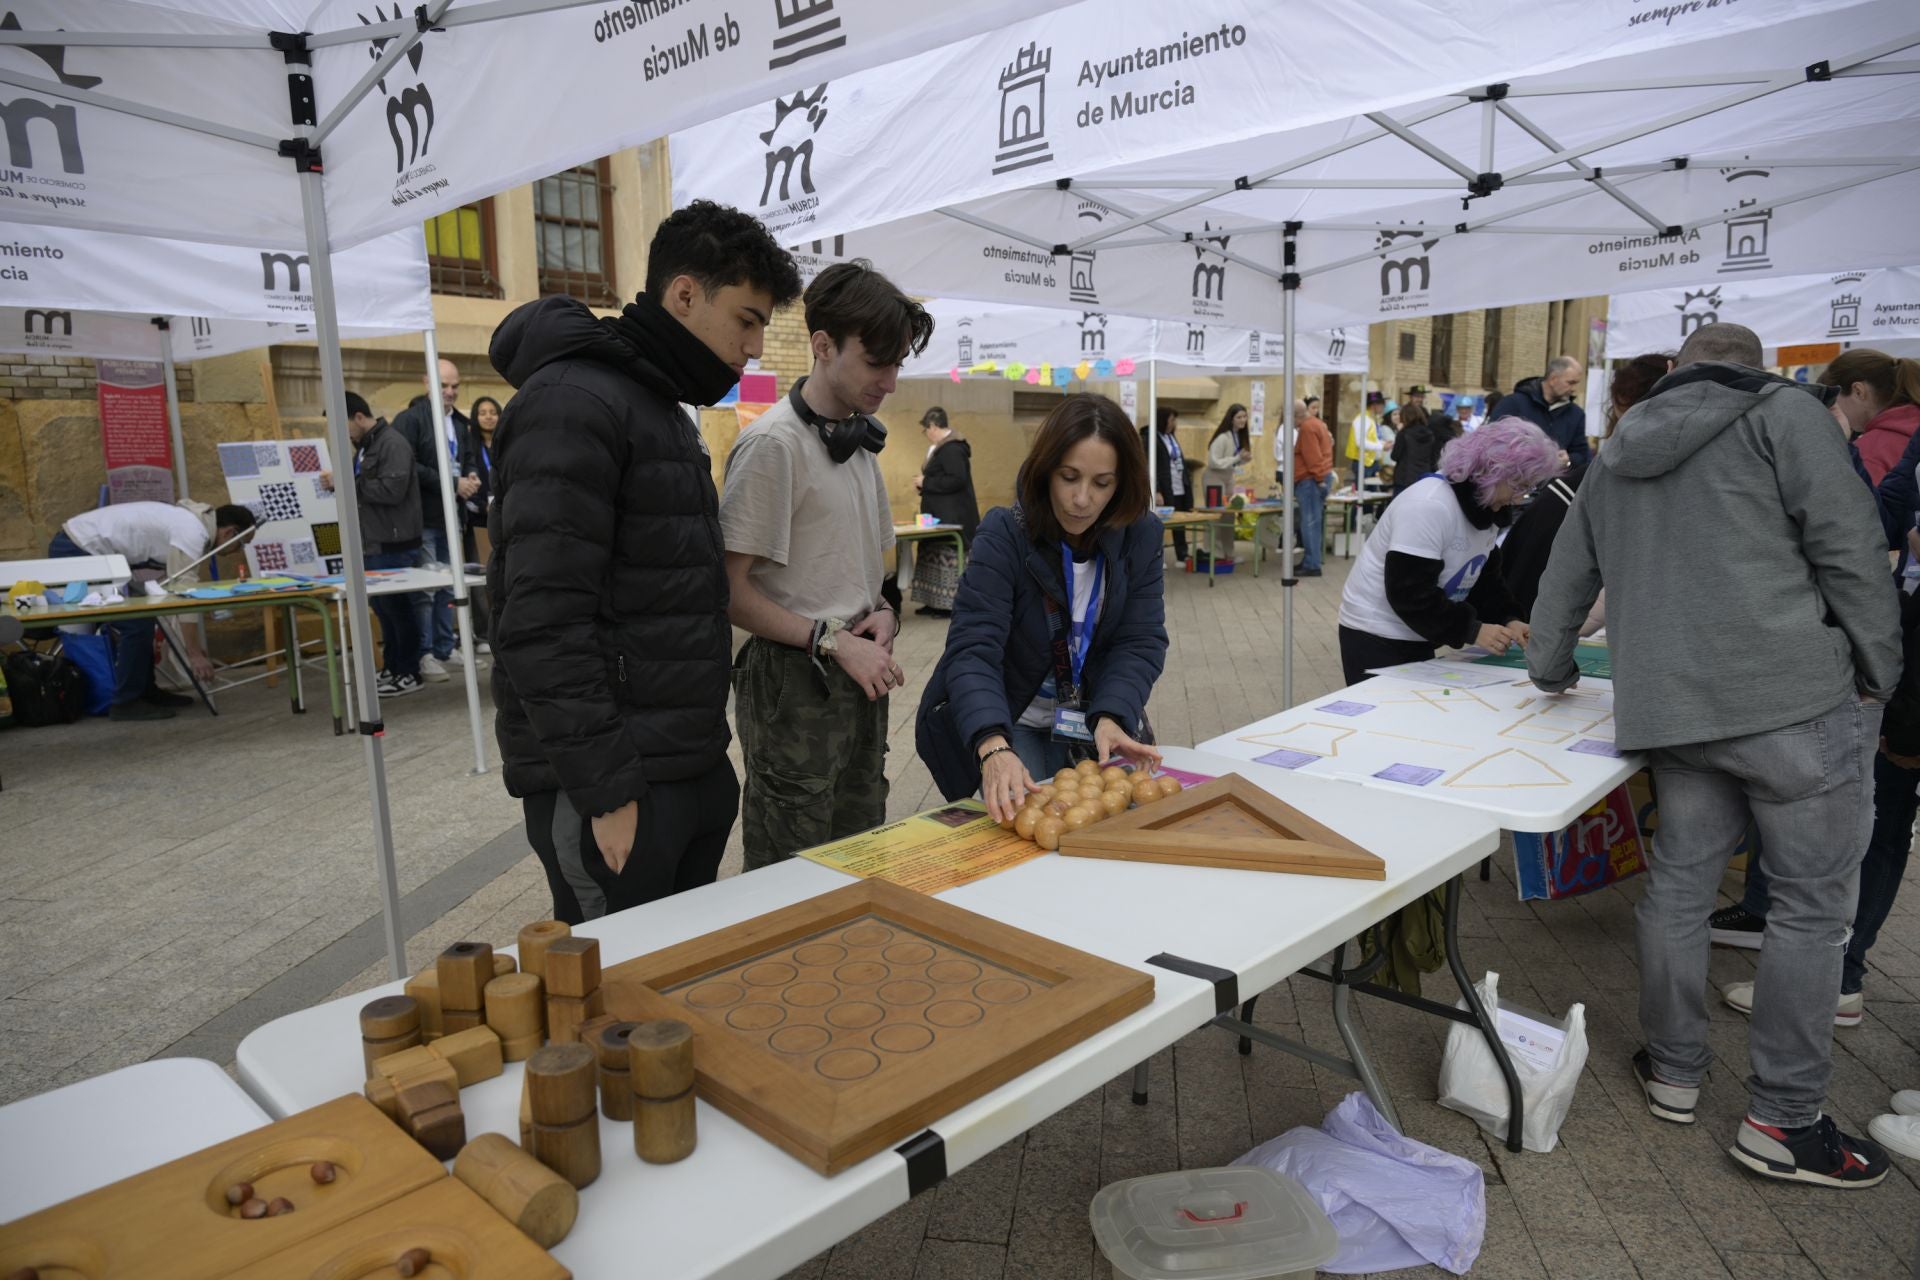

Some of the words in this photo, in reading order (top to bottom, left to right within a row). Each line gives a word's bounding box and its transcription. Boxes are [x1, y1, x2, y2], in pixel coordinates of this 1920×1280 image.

[1077, 23, 1246, 88] Ayuntamiento
[1077, 102, 1104, 128] de
[1111, 80, 1195, 120] Murcia
[788, 196, 819, 214] MURCIA
[1872, 317, 1887, 326] de
